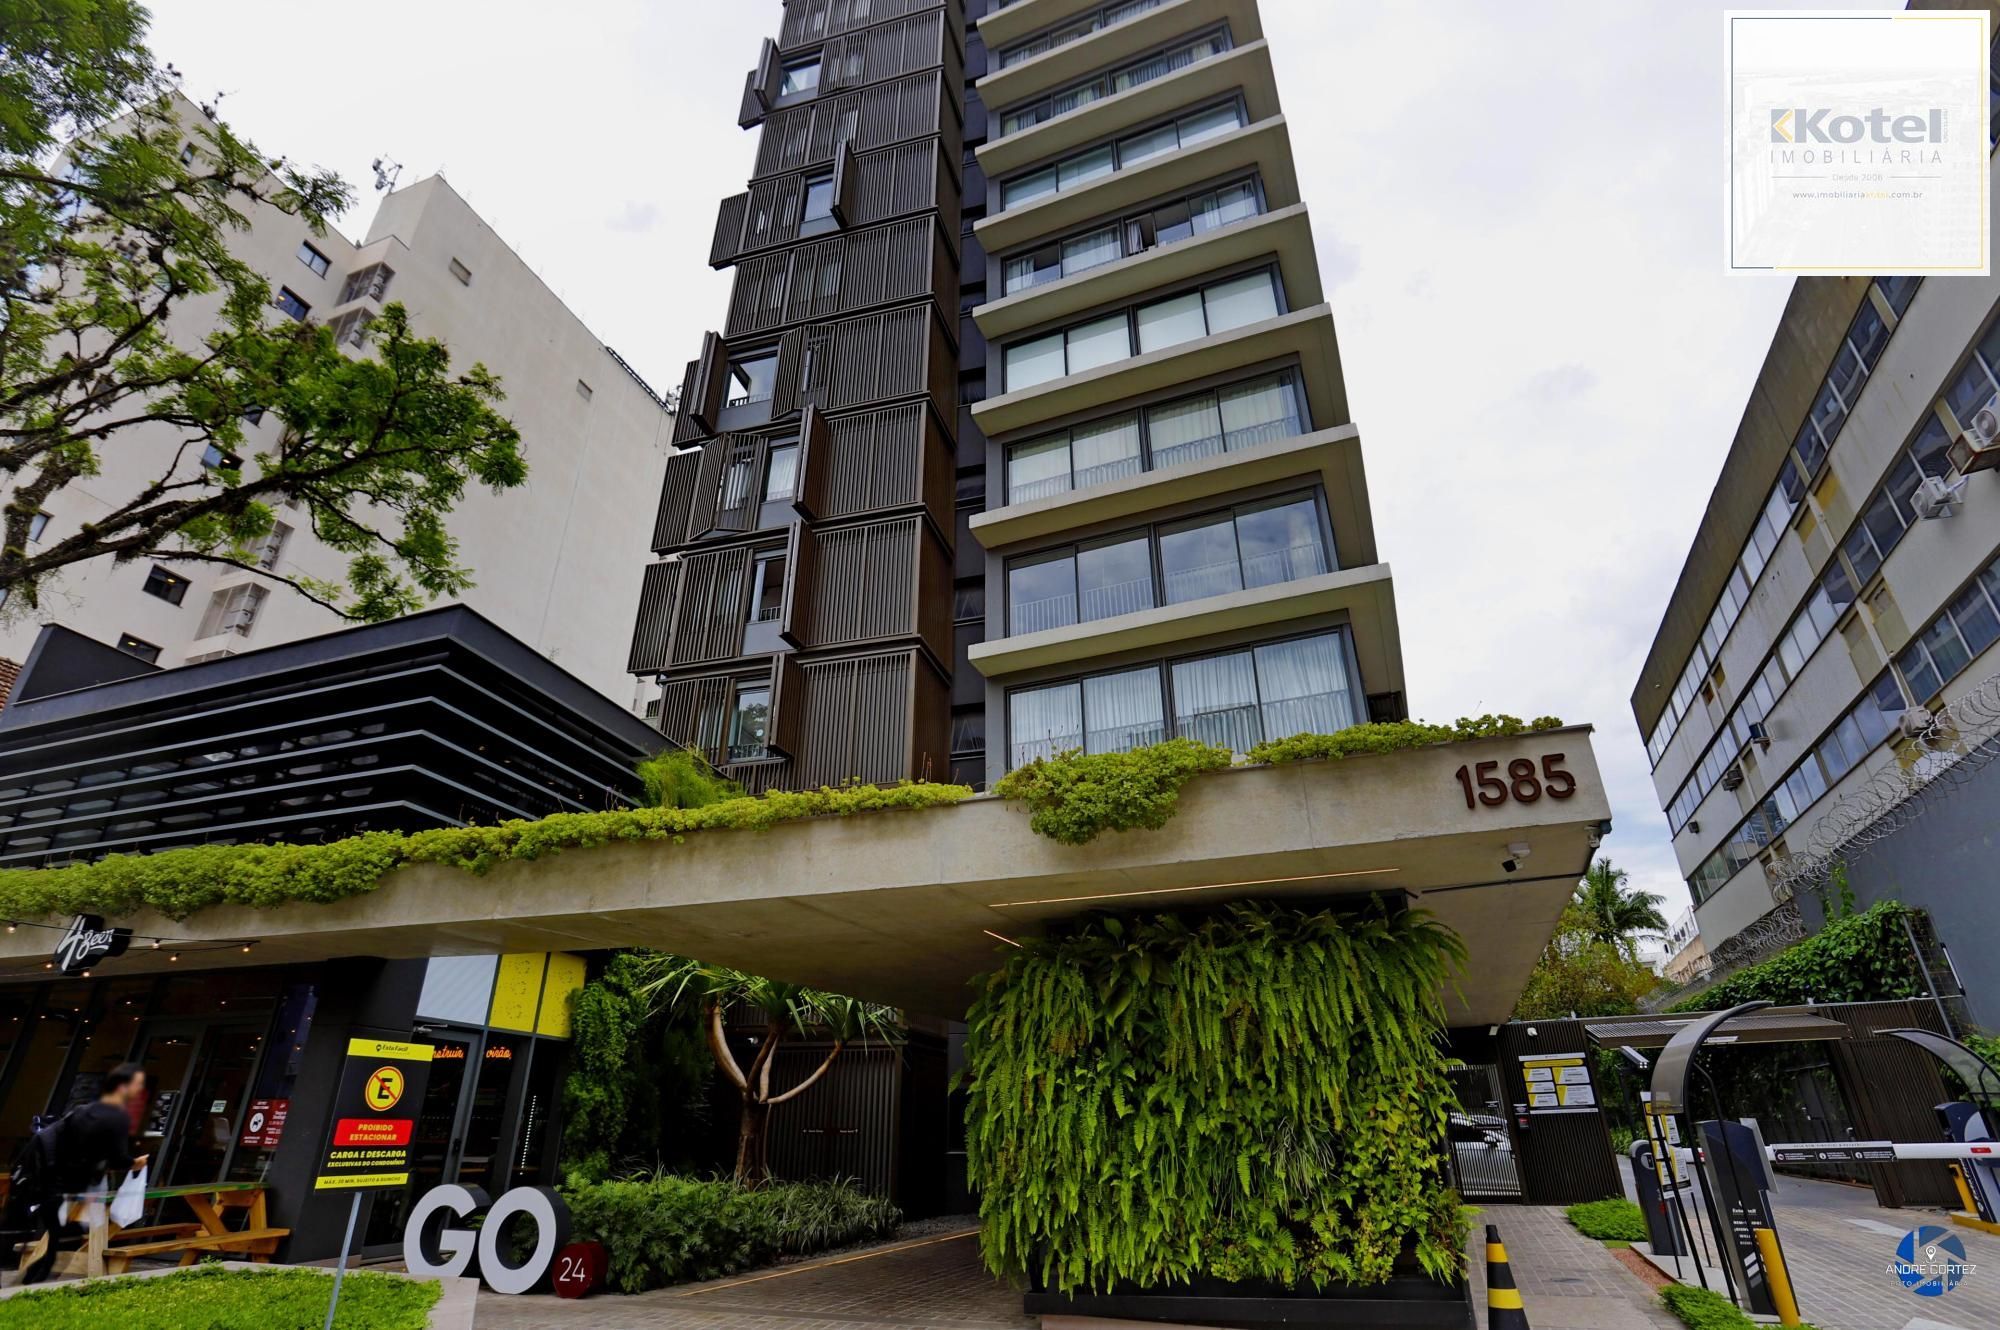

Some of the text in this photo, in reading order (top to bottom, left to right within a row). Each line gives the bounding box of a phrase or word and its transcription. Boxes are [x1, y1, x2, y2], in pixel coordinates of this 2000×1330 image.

[1455, 753, 1576, 810] 1585
[377, 1077, 393, 1100] E
[358, 1123, 393, 1131] PROIBIDO
[350, 1133, 397, 1141] ESTACIONAR
[330, 1149, 407, 1159] CARGA E DESCARGA
[327, 1160, 361, 1168] EXCLUSIVAS
[403, 1184, 586, 1295] GO 24
